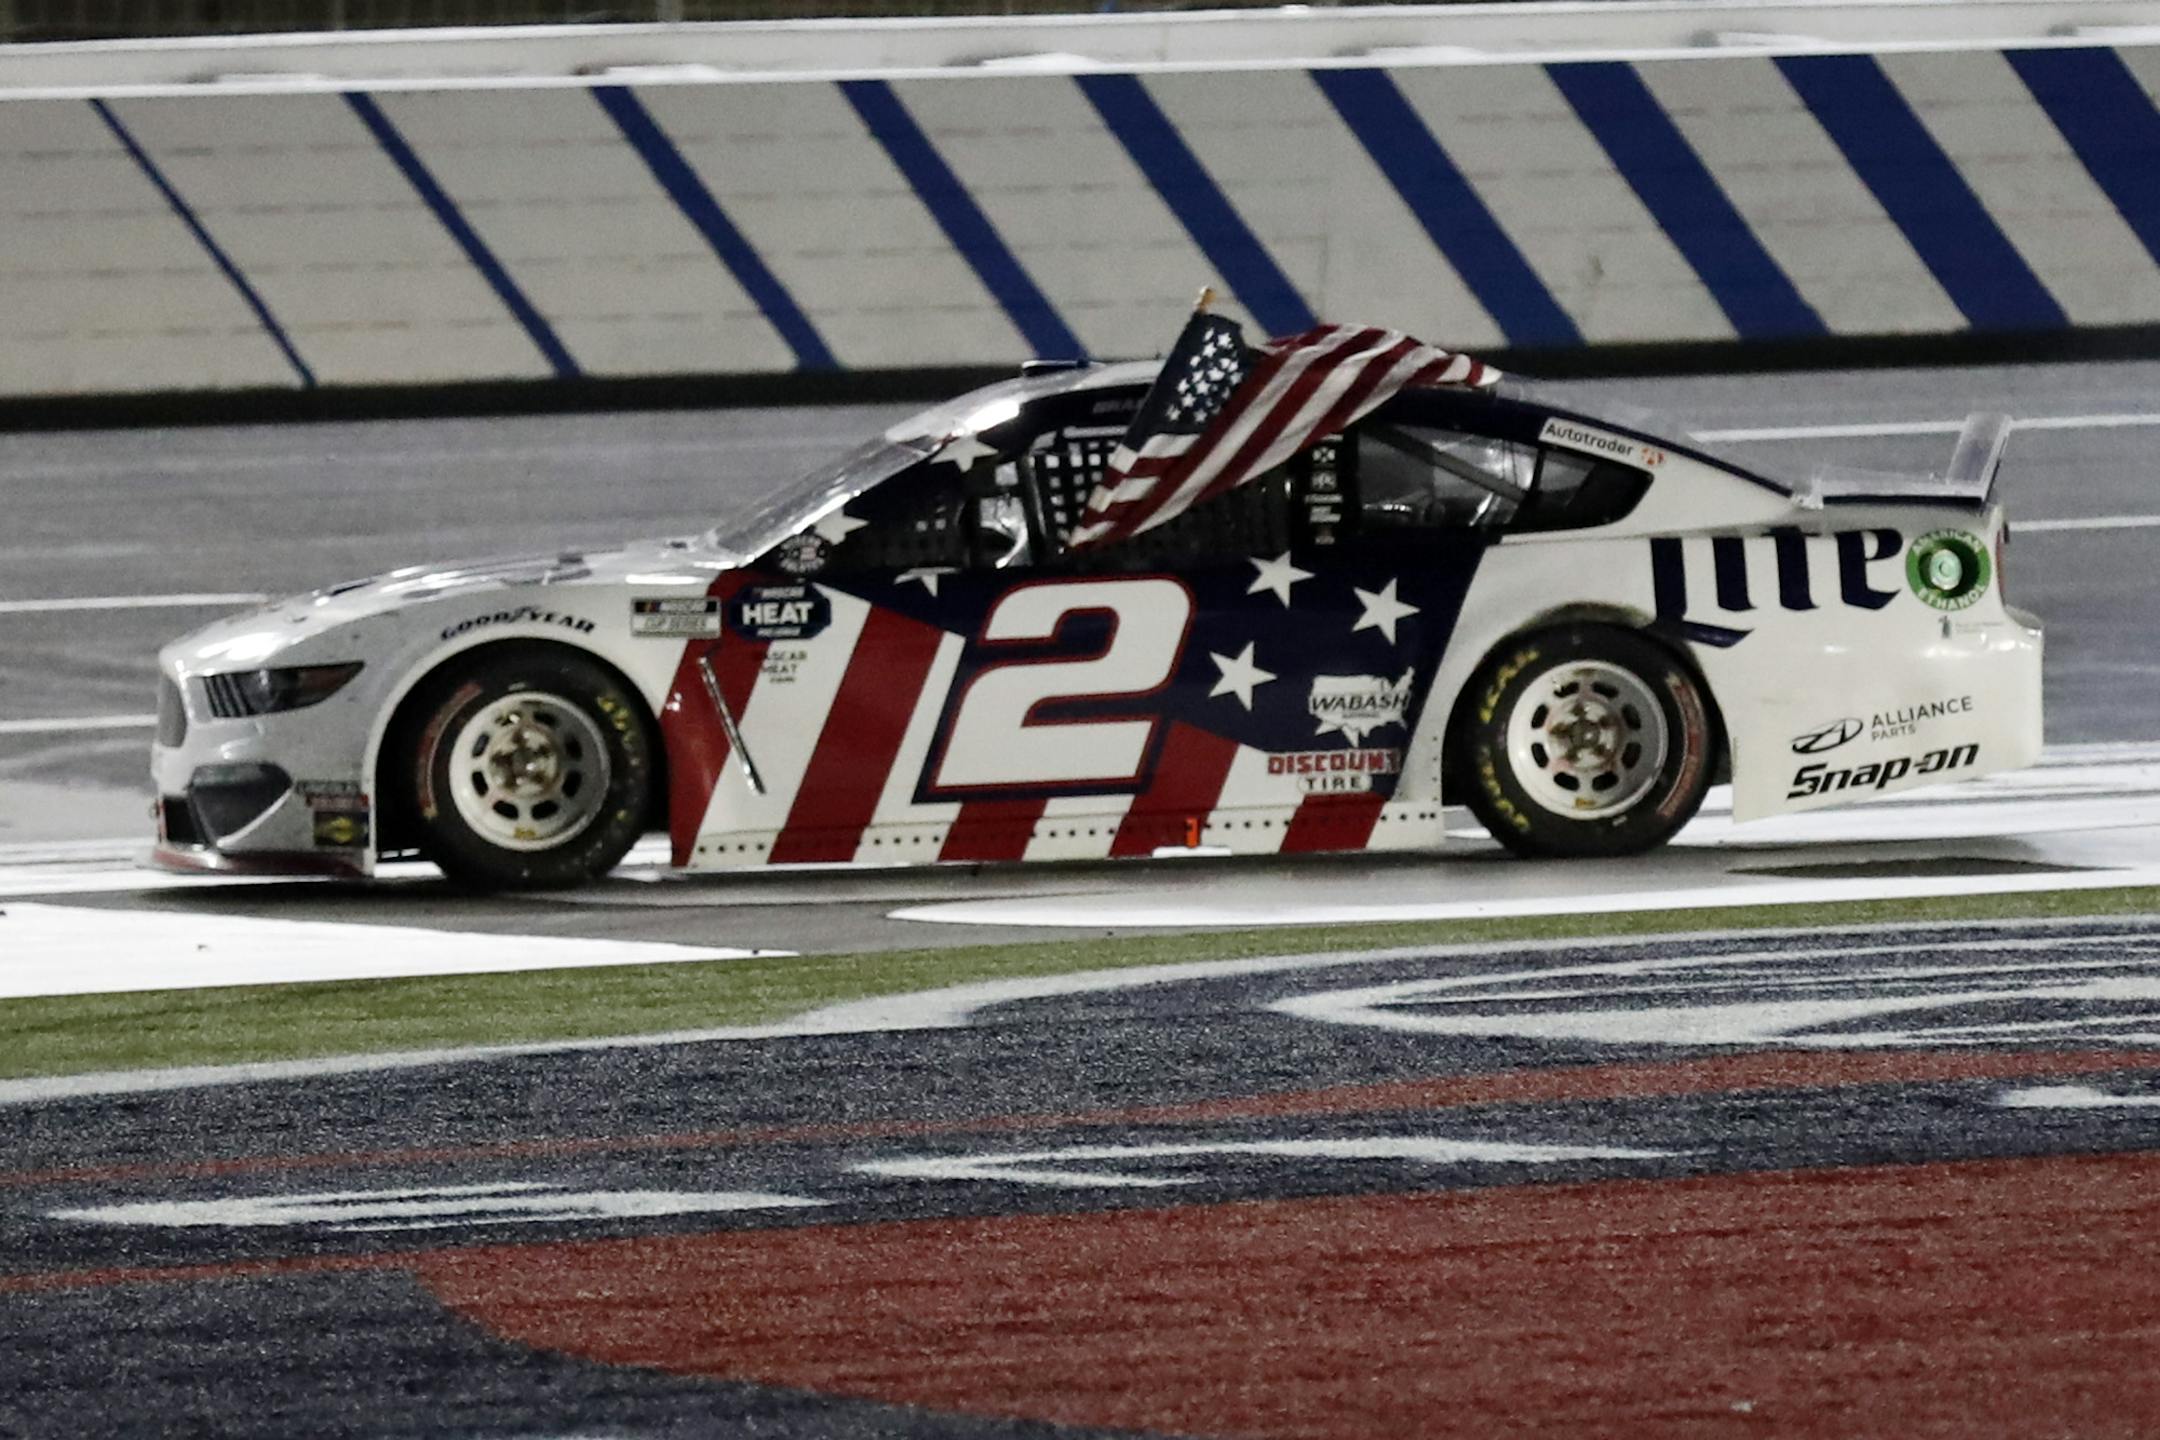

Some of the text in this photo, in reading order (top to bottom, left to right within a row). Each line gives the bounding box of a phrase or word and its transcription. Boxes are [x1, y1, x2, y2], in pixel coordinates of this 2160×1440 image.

[1545, 422, 1634, 456] Autotrader
[1911, 529, 1982, 556] AMERICAN
[1650, 526, 1904, 648] Lite
[1917, 583, 1986, 609] ETHANOL
[439, 605, 595, 641] GOODYEAR
[742, 602, 814, 625] HEAT
[931, 576, 1195, 792] 2
[1311, 692, 1412, 711] WABASH
[1871, 696, 1974, 728] ALLIANCE
[1871, 724, 1917, 742] PARTS
[1267, 751, 1401, 775] DISCOUNT
[1785, 743, 1981, 800] Snap-on
[1305, 776, 1361, 790] TIRE
